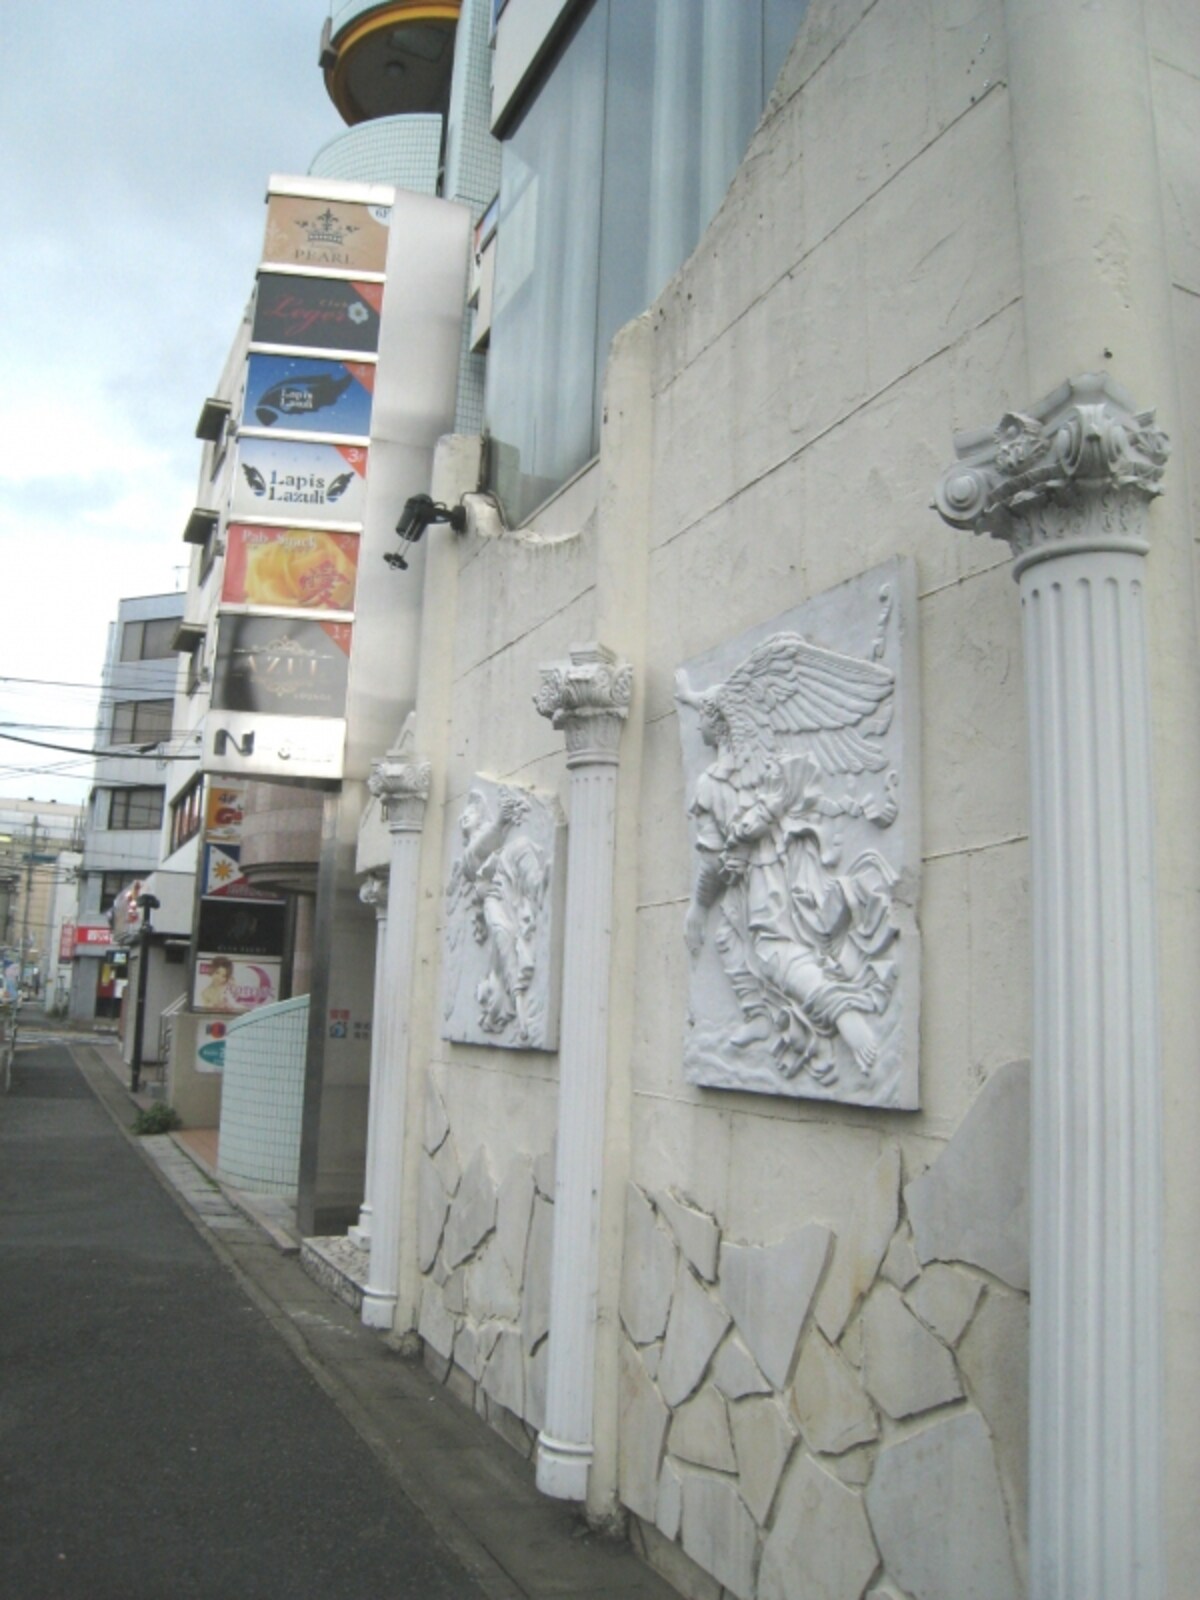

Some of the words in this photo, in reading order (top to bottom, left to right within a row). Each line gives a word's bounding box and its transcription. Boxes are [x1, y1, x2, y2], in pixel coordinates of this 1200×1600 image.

[294, 248, 355, 265] PEARL
[281, 388, 313, 400] Lapis
[270, 469, 326, 491] Lapis
[268, 486, 324, 504] Lazuli
[243, 529, 269, 546] Pub
[277, 533, 317, 549] Snack
[298, 560, 350, 609] 愛
